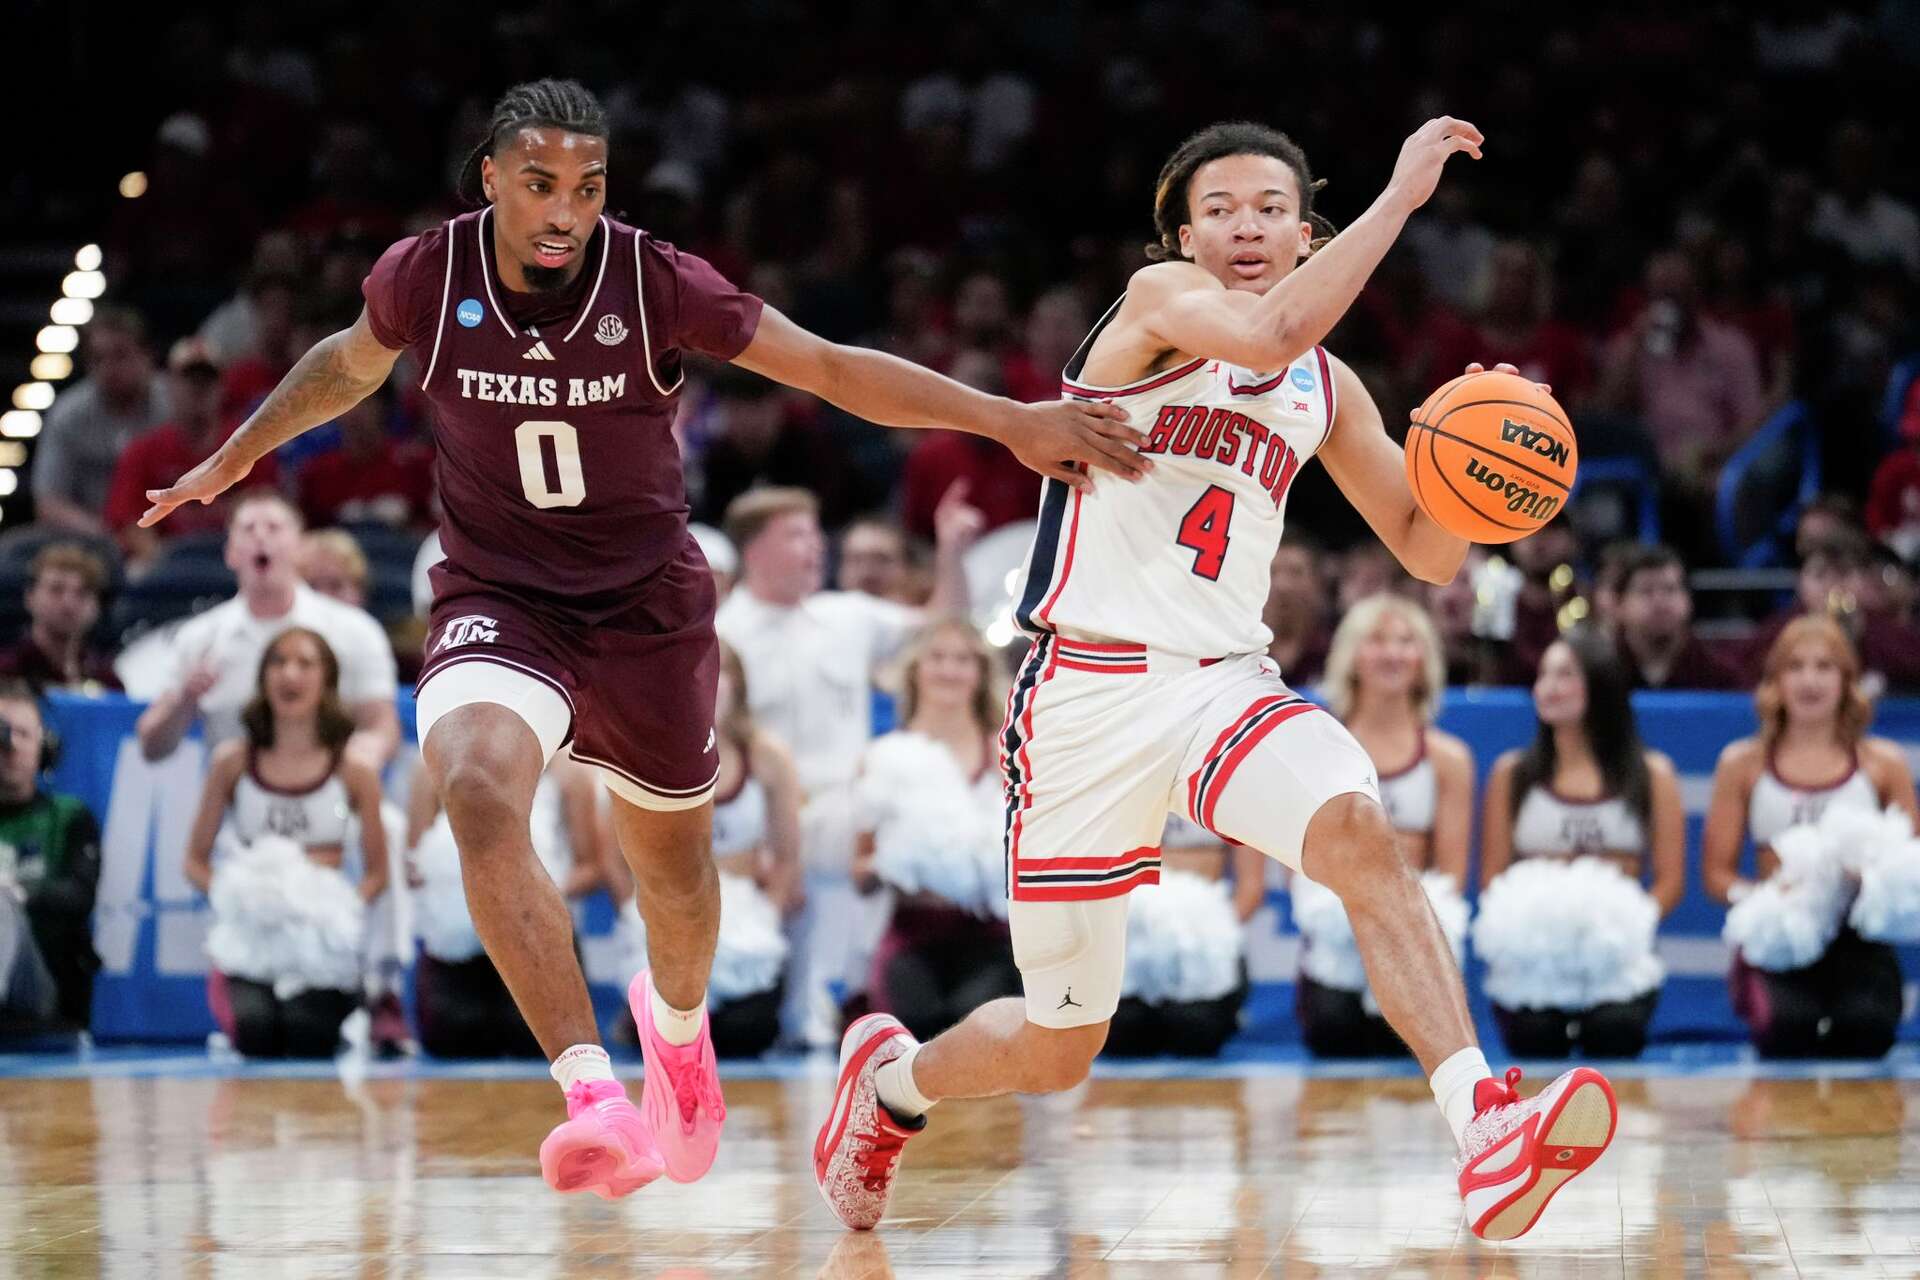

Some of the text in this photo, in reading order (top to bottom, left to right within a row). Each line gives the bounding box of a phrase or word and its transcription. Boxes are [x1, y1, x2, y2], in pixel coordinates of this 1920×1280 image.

[459, 310, 481, 323] NCAA
[600, 316, 621, 337] SEC
[457, 368, 626, 406] TEXAS A&M
[514, 420, 586, 509] 0
[1138, 405, 1299, 512] HOUSTON
[1501, 418, 1570, 468] NCAA
[1465, 457, 1559, 520] Wilson
[1176, 484, 1236, 582] 4
